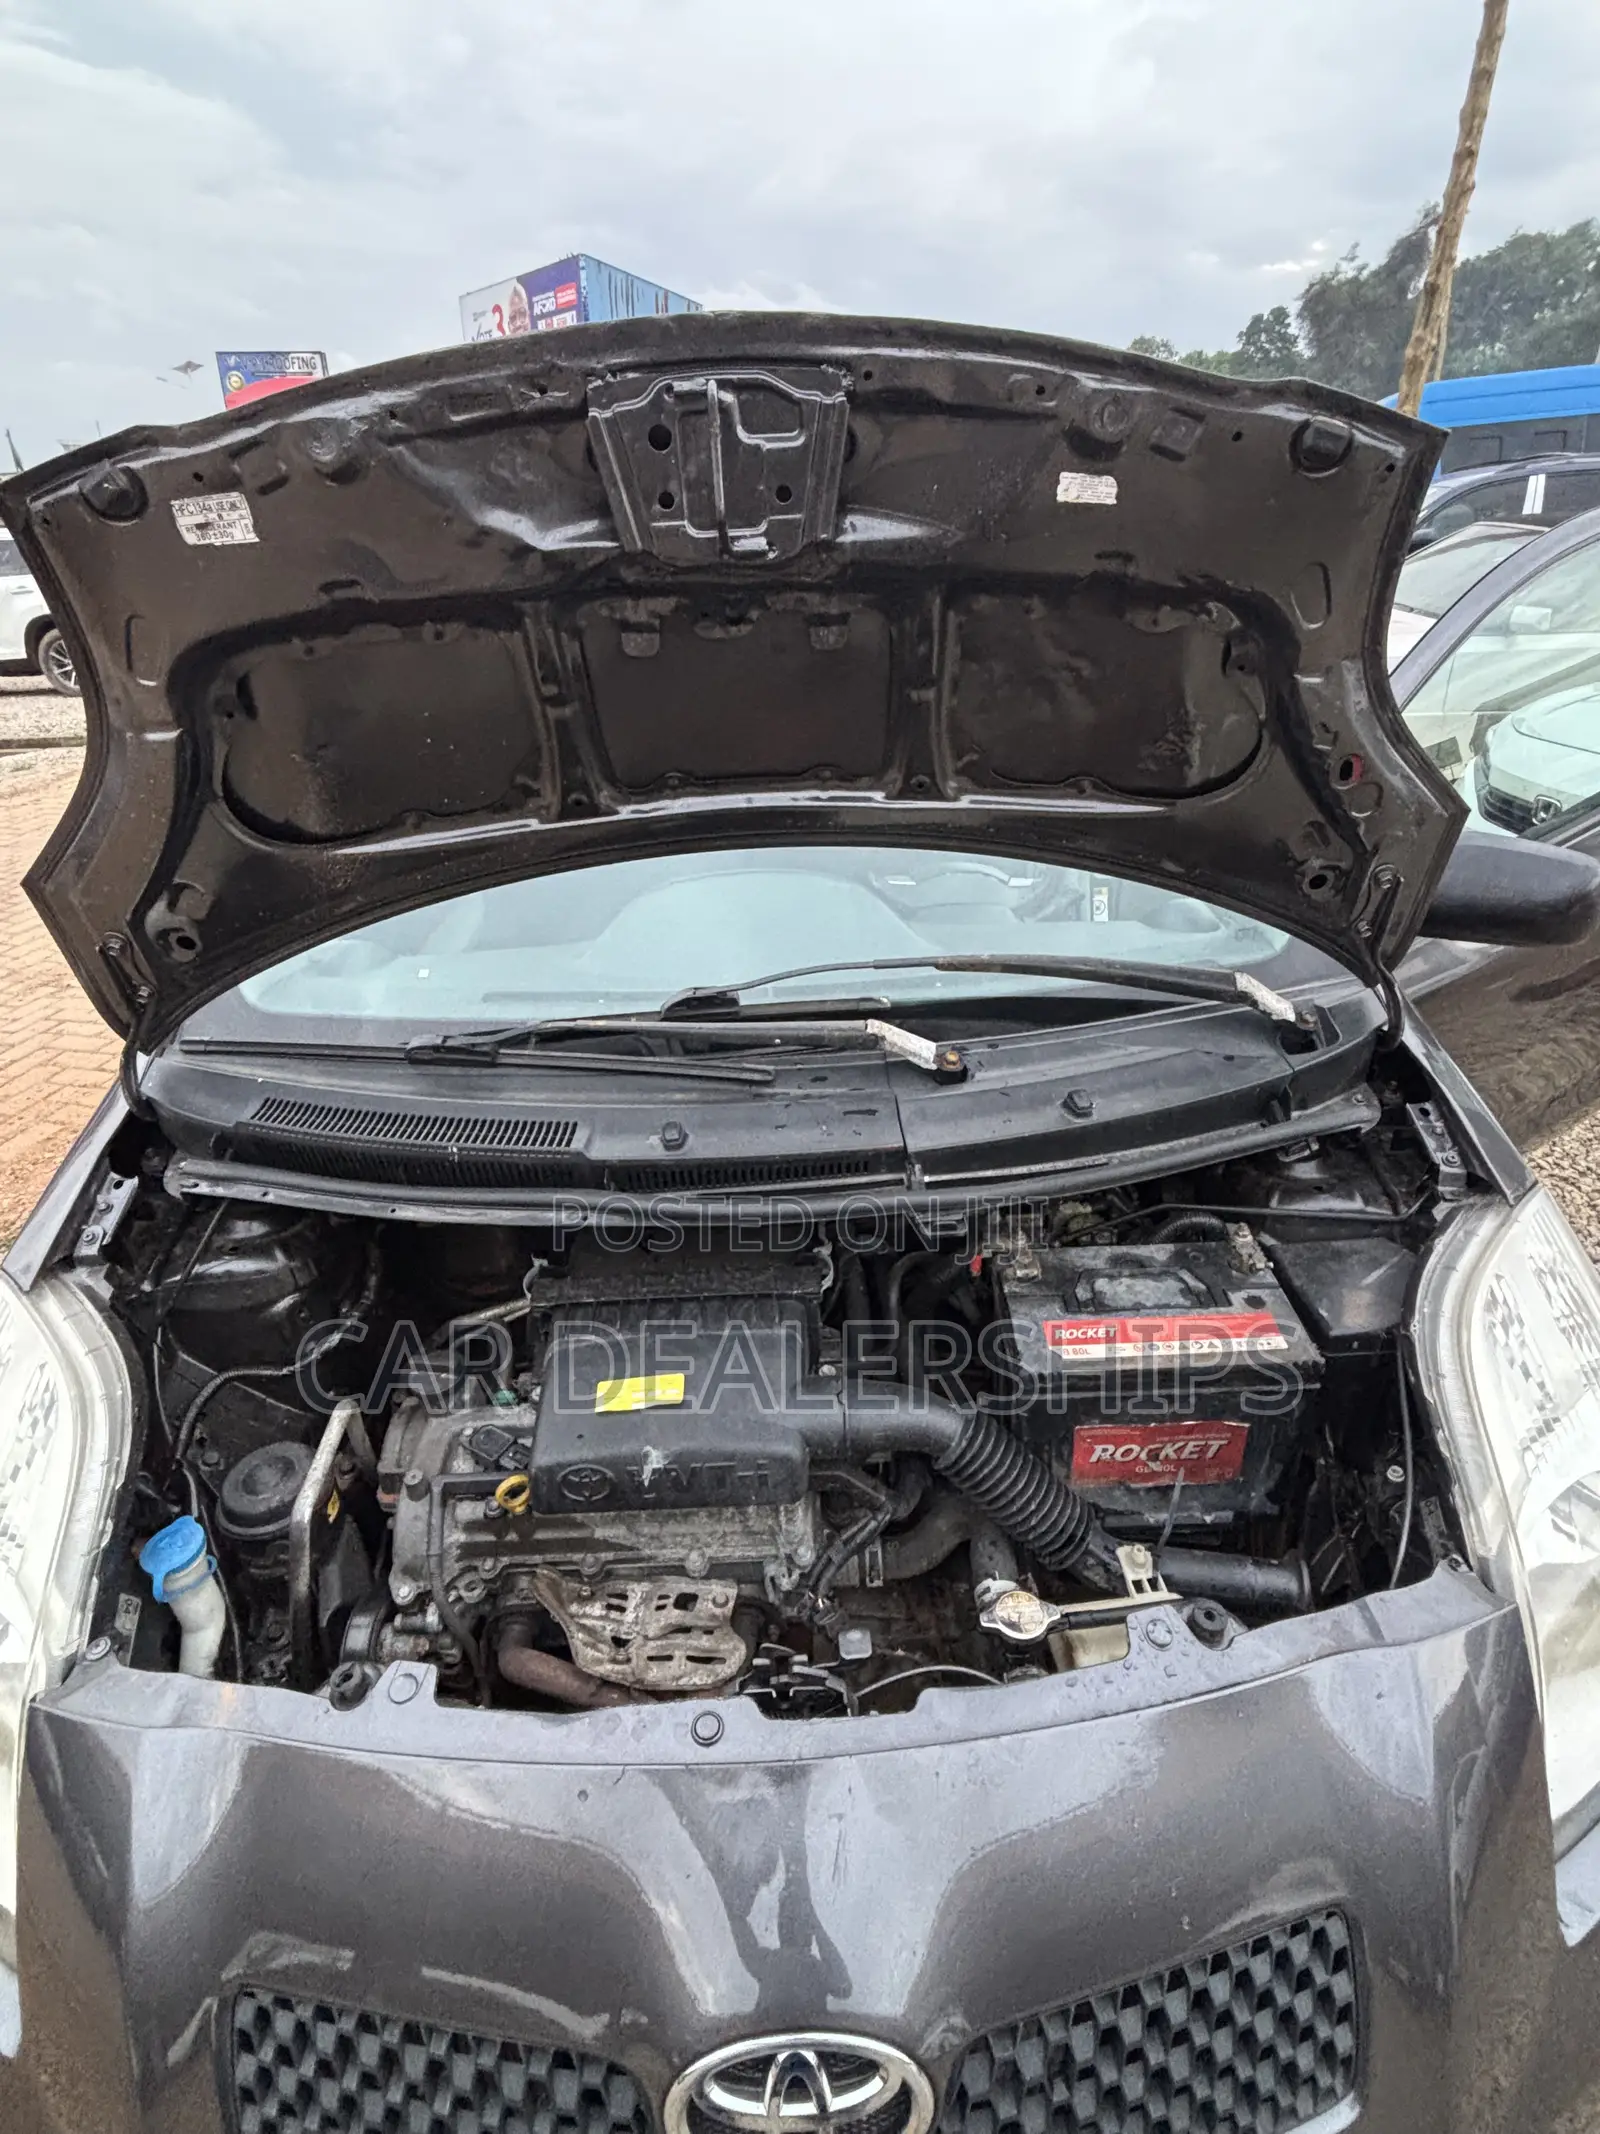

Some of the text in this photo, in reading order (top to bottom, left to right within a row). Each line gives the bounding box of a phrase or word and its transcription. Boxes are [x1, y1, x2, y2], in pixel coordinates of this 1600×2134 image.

[185, 521, 237, 533] REGERANT
[1054, 1327, 1118, 1339] ROCKET
[1088, 1439, 1229, 1464] ROCKET
